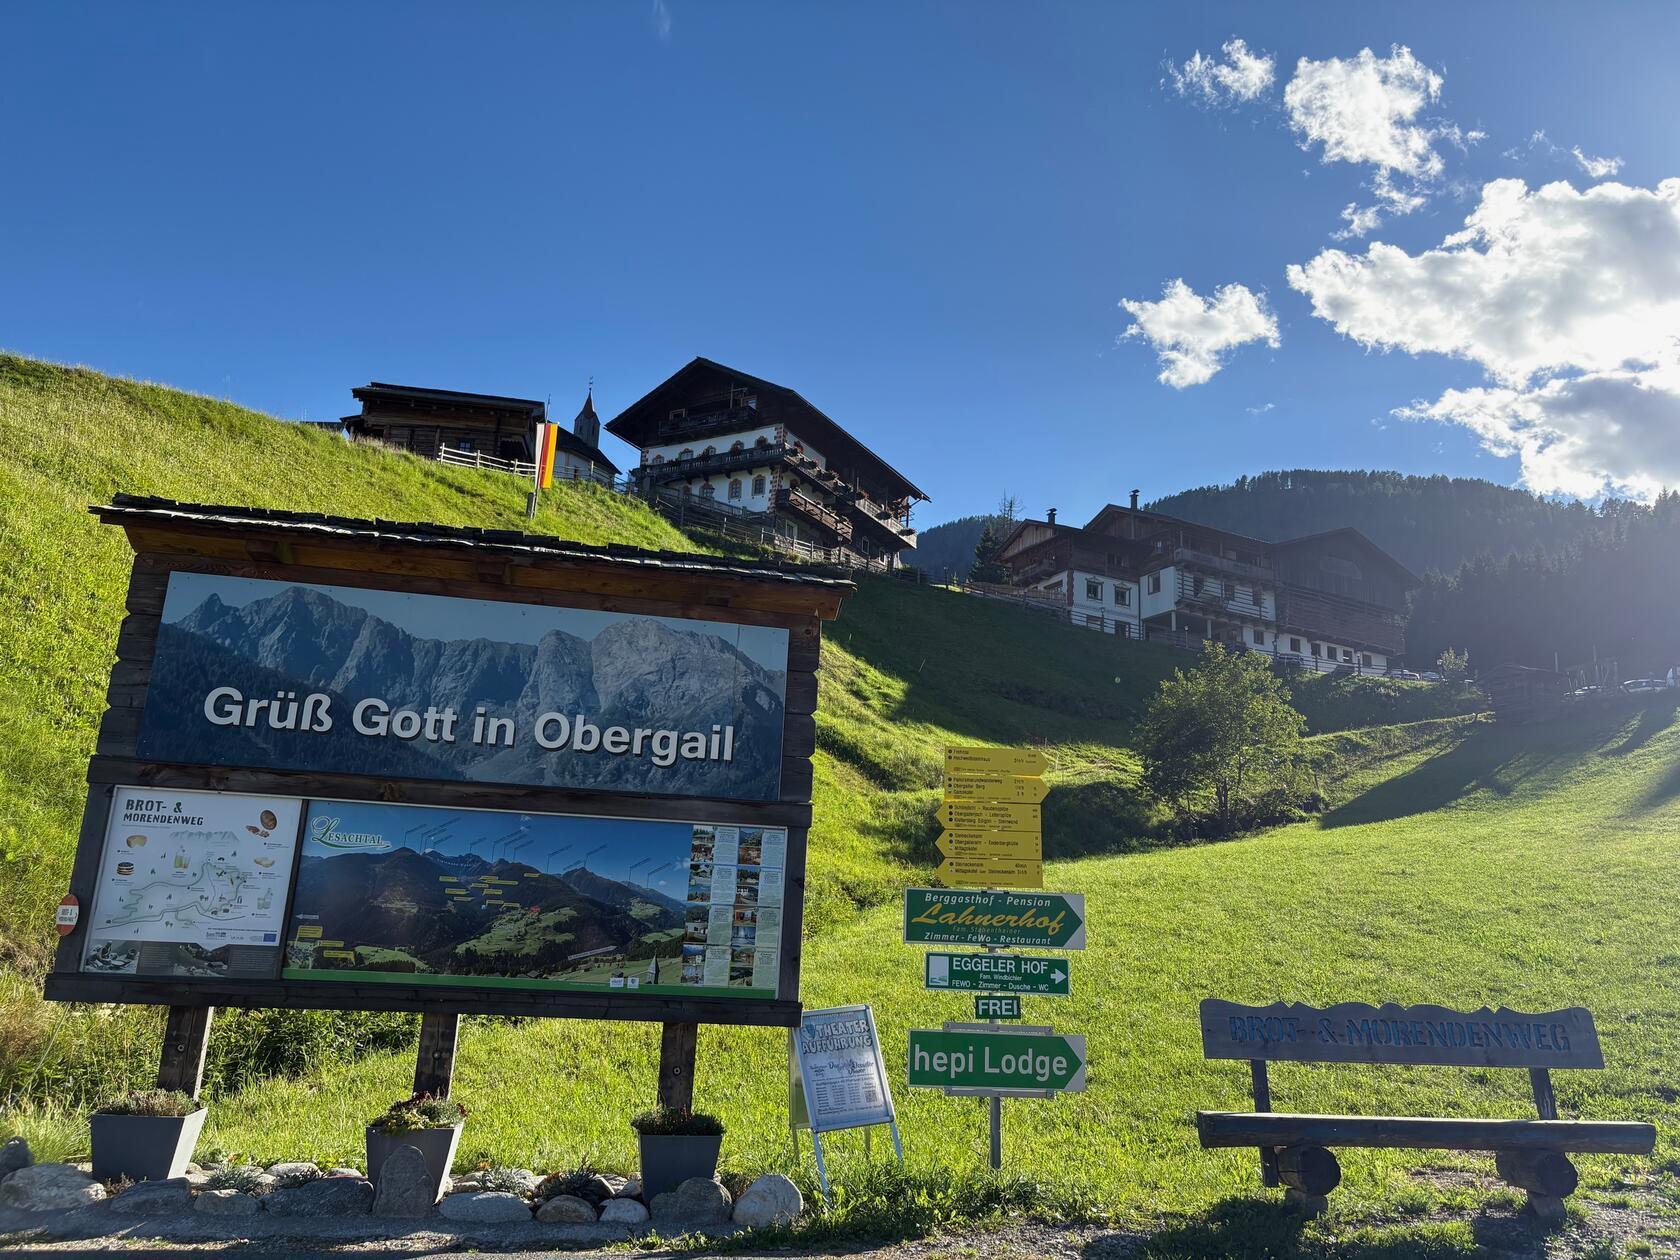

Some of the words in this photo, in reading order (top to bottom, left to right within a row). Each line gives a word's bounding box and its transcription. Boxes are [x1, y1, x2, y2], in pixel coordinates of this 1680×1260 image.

[203, 686, 332, 732] Grüß
[352, 698, 457, 743] Gott
[472, 706, 515, 746] in
[534, 711, 734, 767] Obergail
[173, 801, 183, 813] &
[123, 813, 204, 826] MORENDENWEG
[924, 892, 995, 906] Berggasthof
[1006, 896, 1051, 907] Pension
[911, 903, 1066, 936] Lahnerhof
[924, 932, 958, 941] Zimmer
[967, 934, 991, 942] FeWo
[1000, 935, 1051, 945] Restaurant
[952, 958, 1016, 973] EGGELER
[1022, 961, 1048, 974] HOF
[952, 980, 970, 988] FEWO
[978, 981, 1001, 989] Zimmer
[1038, 984, 1049, 992] WC
[978, 1000, 1018, 1016] FREI
[816, 1020, 870, 1036] THEATER
[1317, 1019, 1338, 1044] &
[1347, 1018, 1571, 1052] MORENDENWEG
[802, 1035, 873, 1054] AUFFÜHRUNG
[914, 1044, 974, 1079] hepi
[984, 1046, 1068, 1082] Lodge
